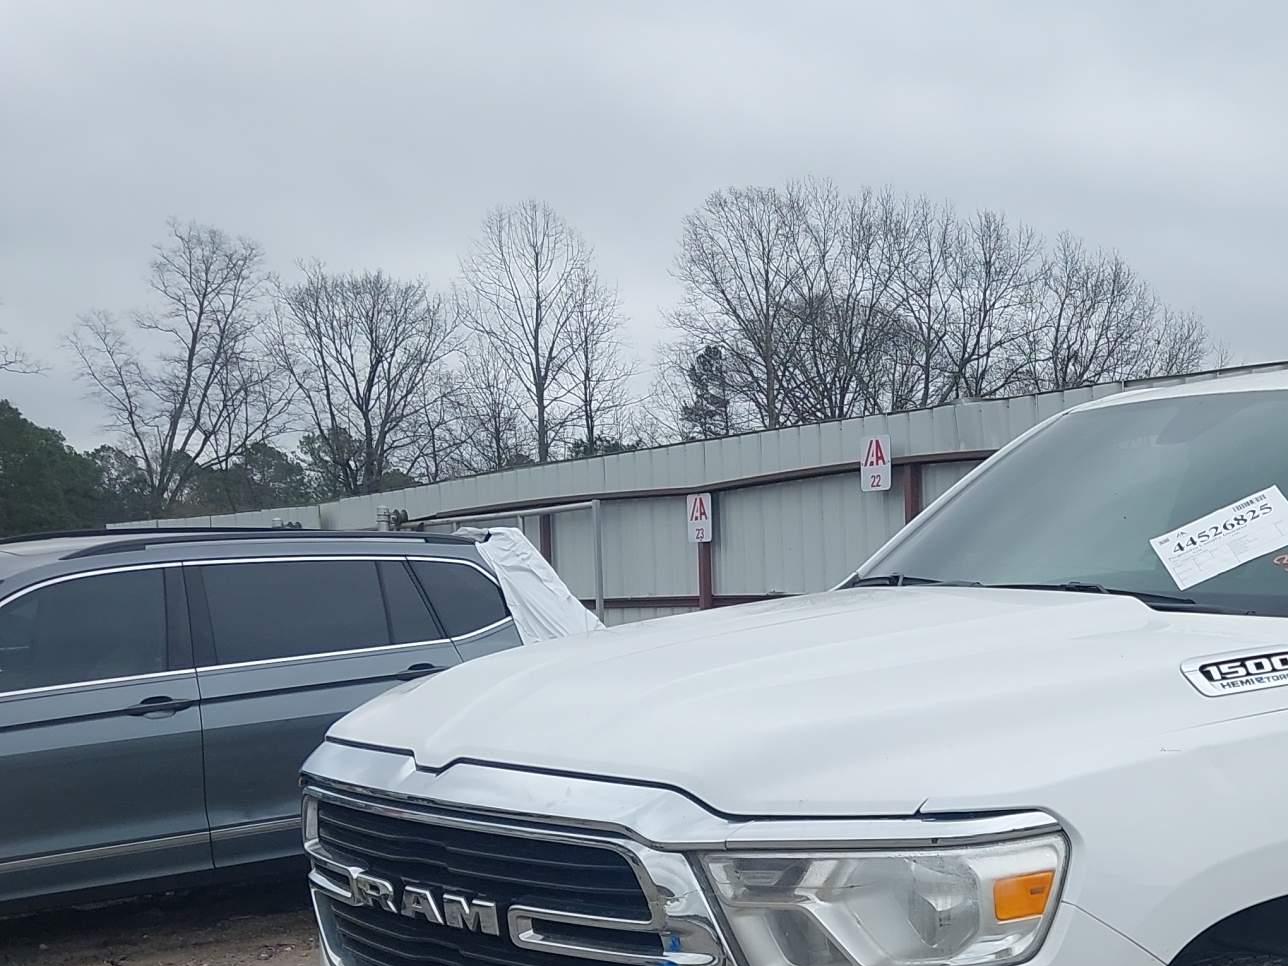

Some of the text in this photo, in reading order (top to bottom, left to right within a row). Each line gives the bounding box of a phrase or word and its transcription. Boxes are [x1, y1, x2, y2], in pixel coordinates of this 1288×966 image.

[870, 474, 881, 488] 22
[695, 527, 705, 539] 23
[1173, 502, 1274, 555] 44526825
[355, 873, 500, 937] RAM
